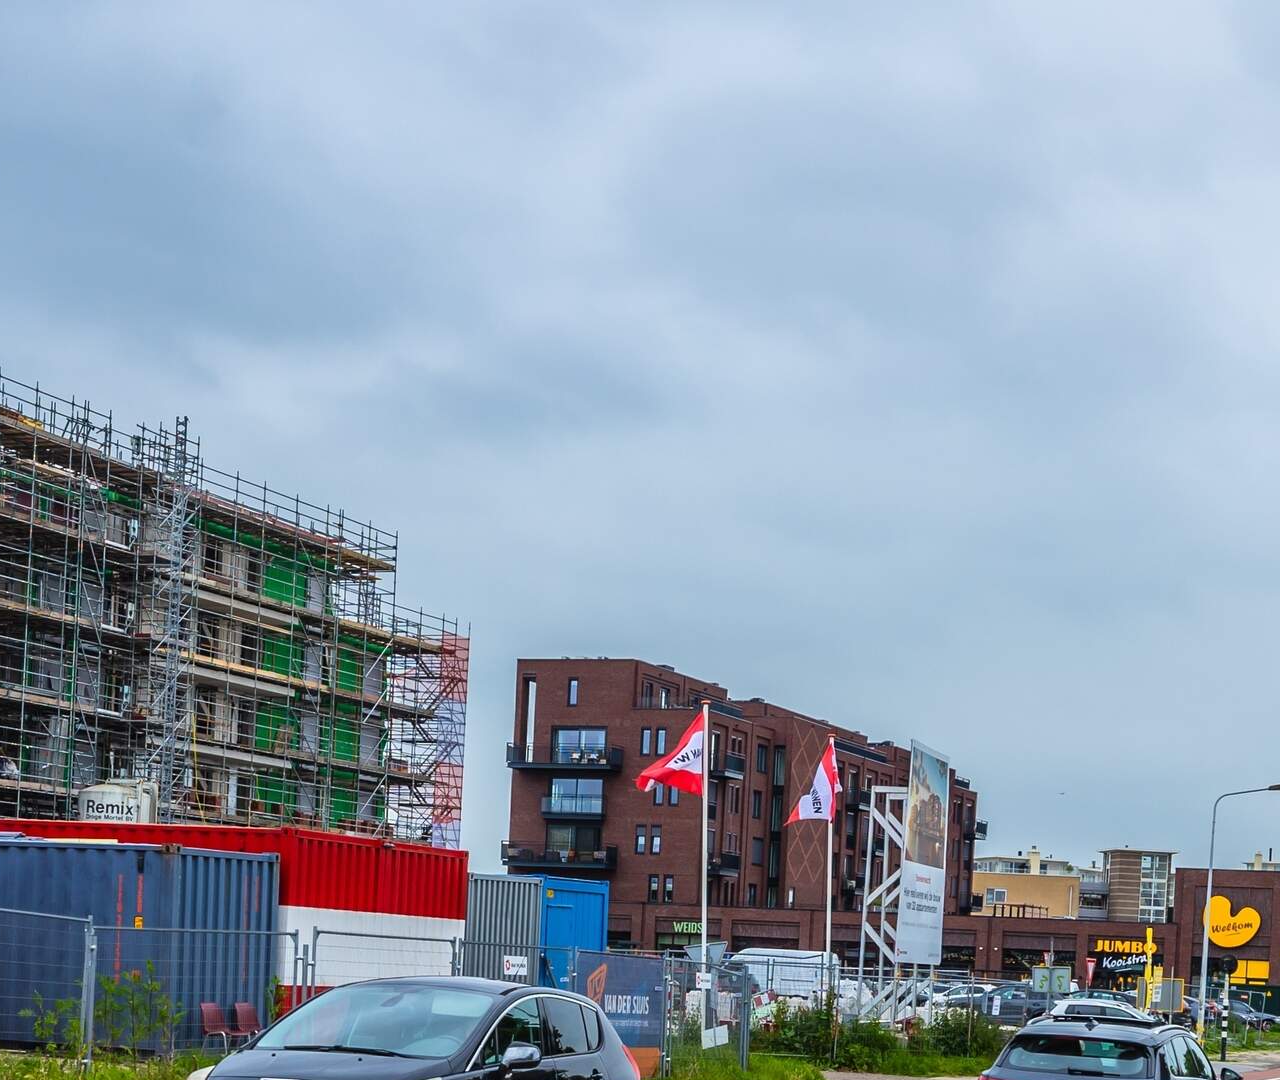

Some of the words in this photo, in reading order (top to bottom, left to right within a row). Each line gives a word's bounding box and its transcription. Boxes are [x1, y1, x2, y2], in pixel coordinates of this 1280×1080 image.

[86, 799, 133, 815] Remix
[1211, 922, 1253, 934] Welkom
[1094, 940, 1158, 954] JUMBO
[1102, 954, 1148, 969] Kooistra
[604, 994, 617, 1013] VAN
[617, 994, 631, 1014] DER
